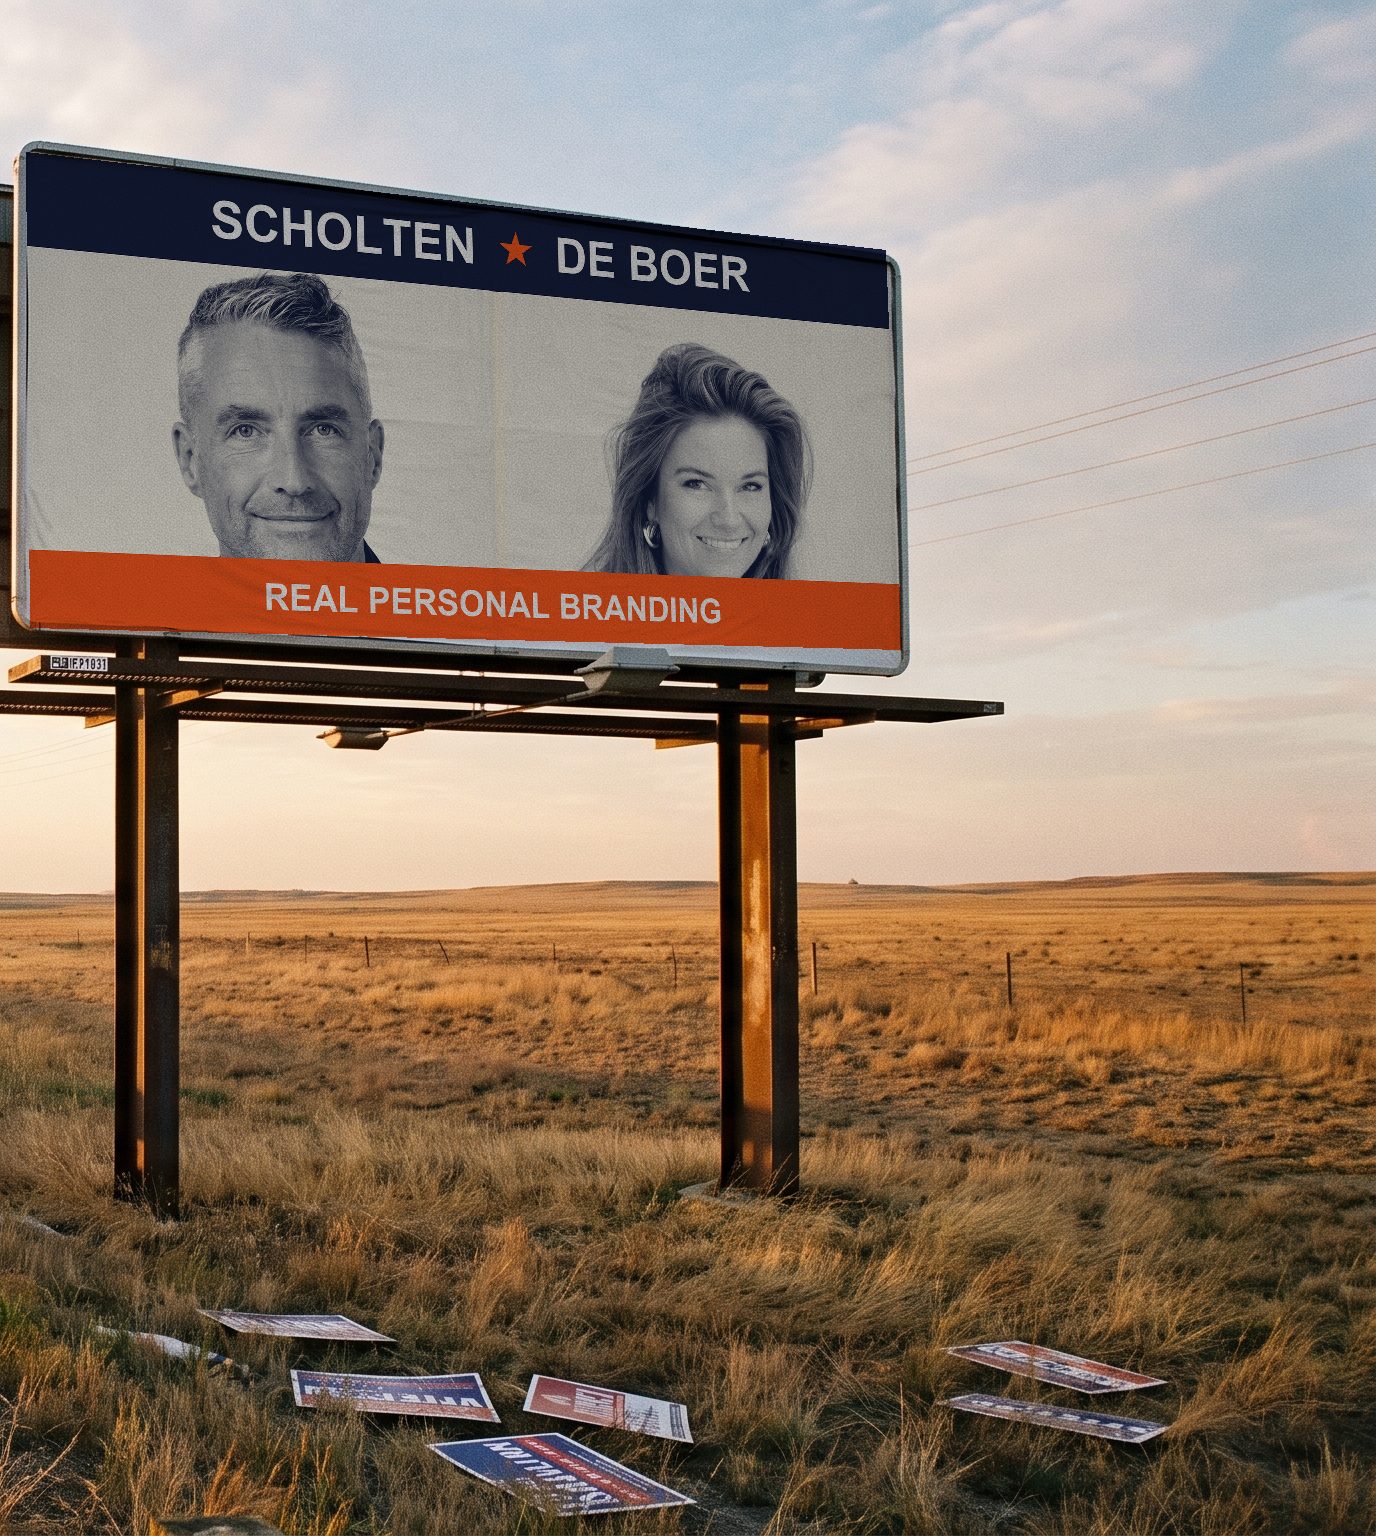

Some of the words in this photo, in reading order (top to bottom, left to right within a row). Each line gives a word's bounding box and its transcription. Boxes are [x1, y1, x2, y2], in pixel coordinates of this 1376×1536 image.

[210, 200, 475, 264] SCHOLTEN
[556, 237, 615, 279] DE
[630, 245, 750, 293] BOER
[264, 582, 358, 613] REAL
[369, 586, 550, 620] PERSONAL
[559, 592, 722, 625] BRANDING
